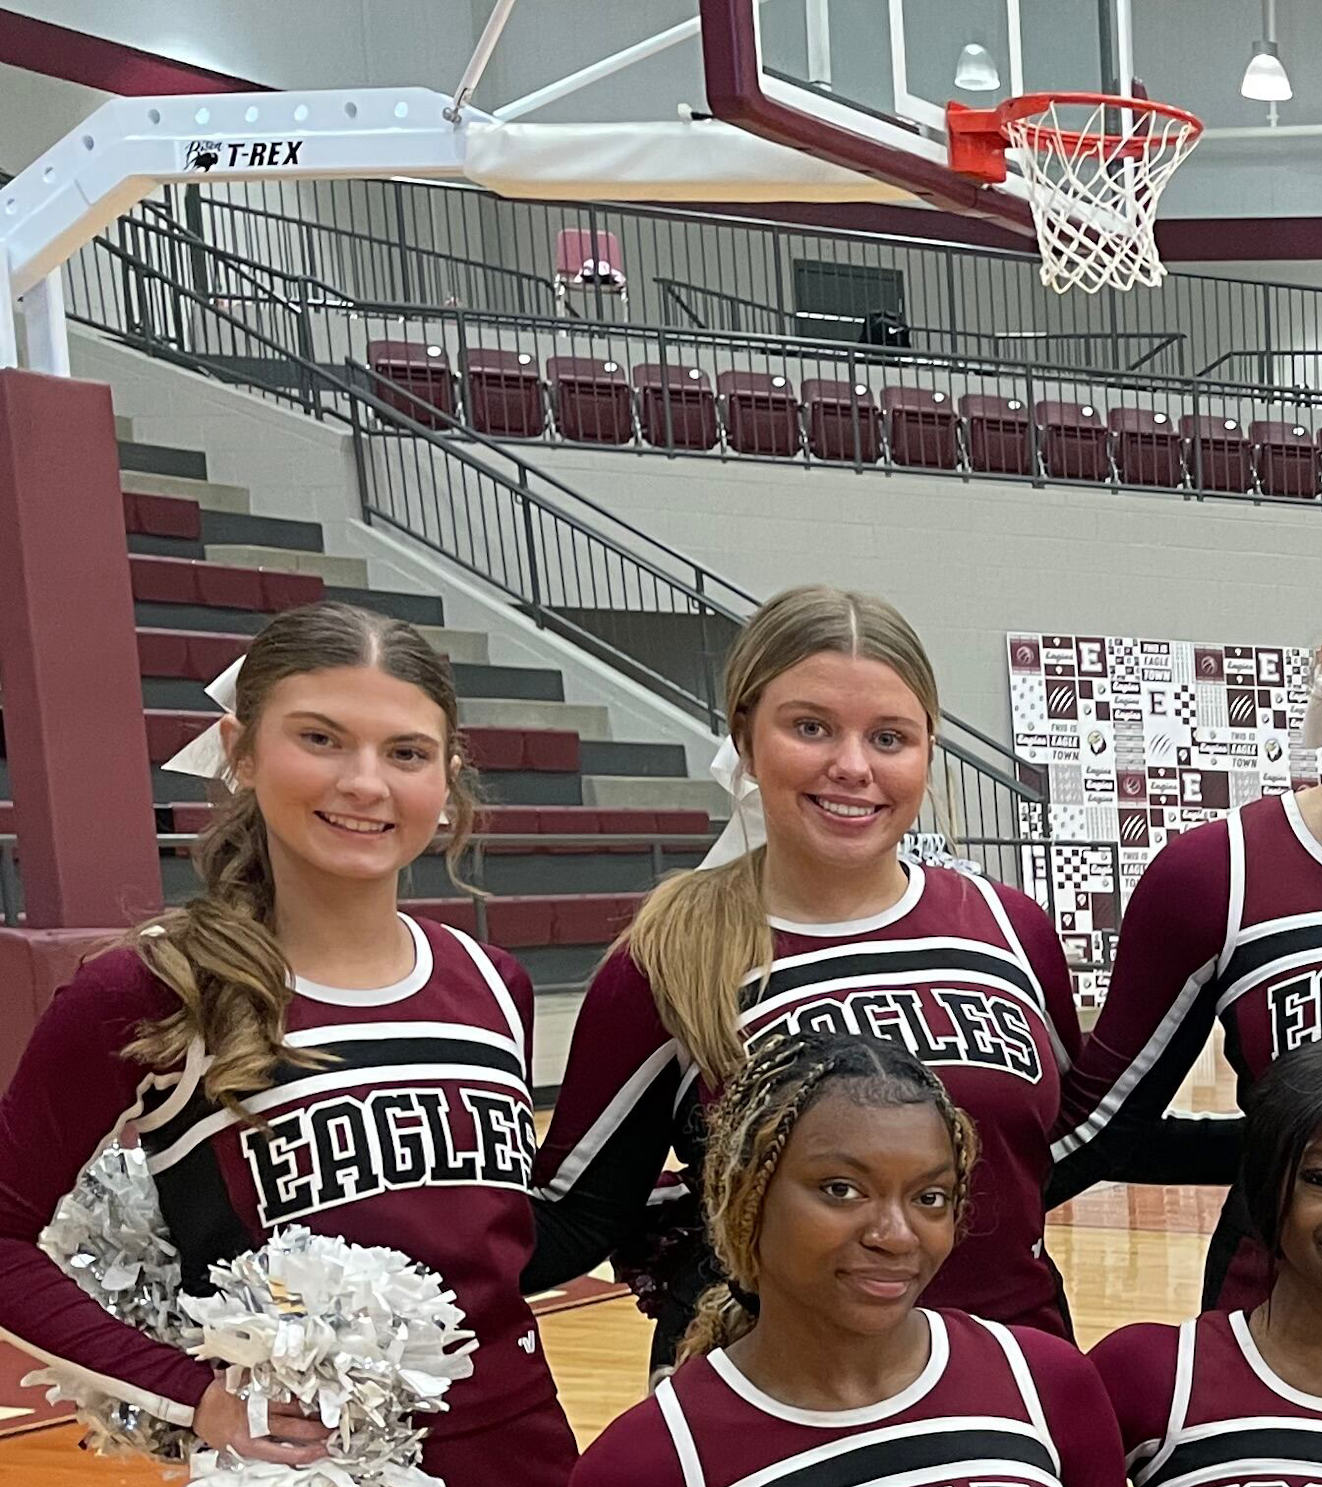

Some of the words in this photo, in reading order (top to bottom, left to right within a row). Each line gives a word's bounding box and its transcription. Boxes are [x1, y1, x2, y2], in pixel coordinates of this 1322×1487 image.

[227, 141, 303, 167] T-REX
[1079, 642, 1103, 673] E
[1258, 652, 1280, 682] E
[1150, 691, 1167, 715] E
